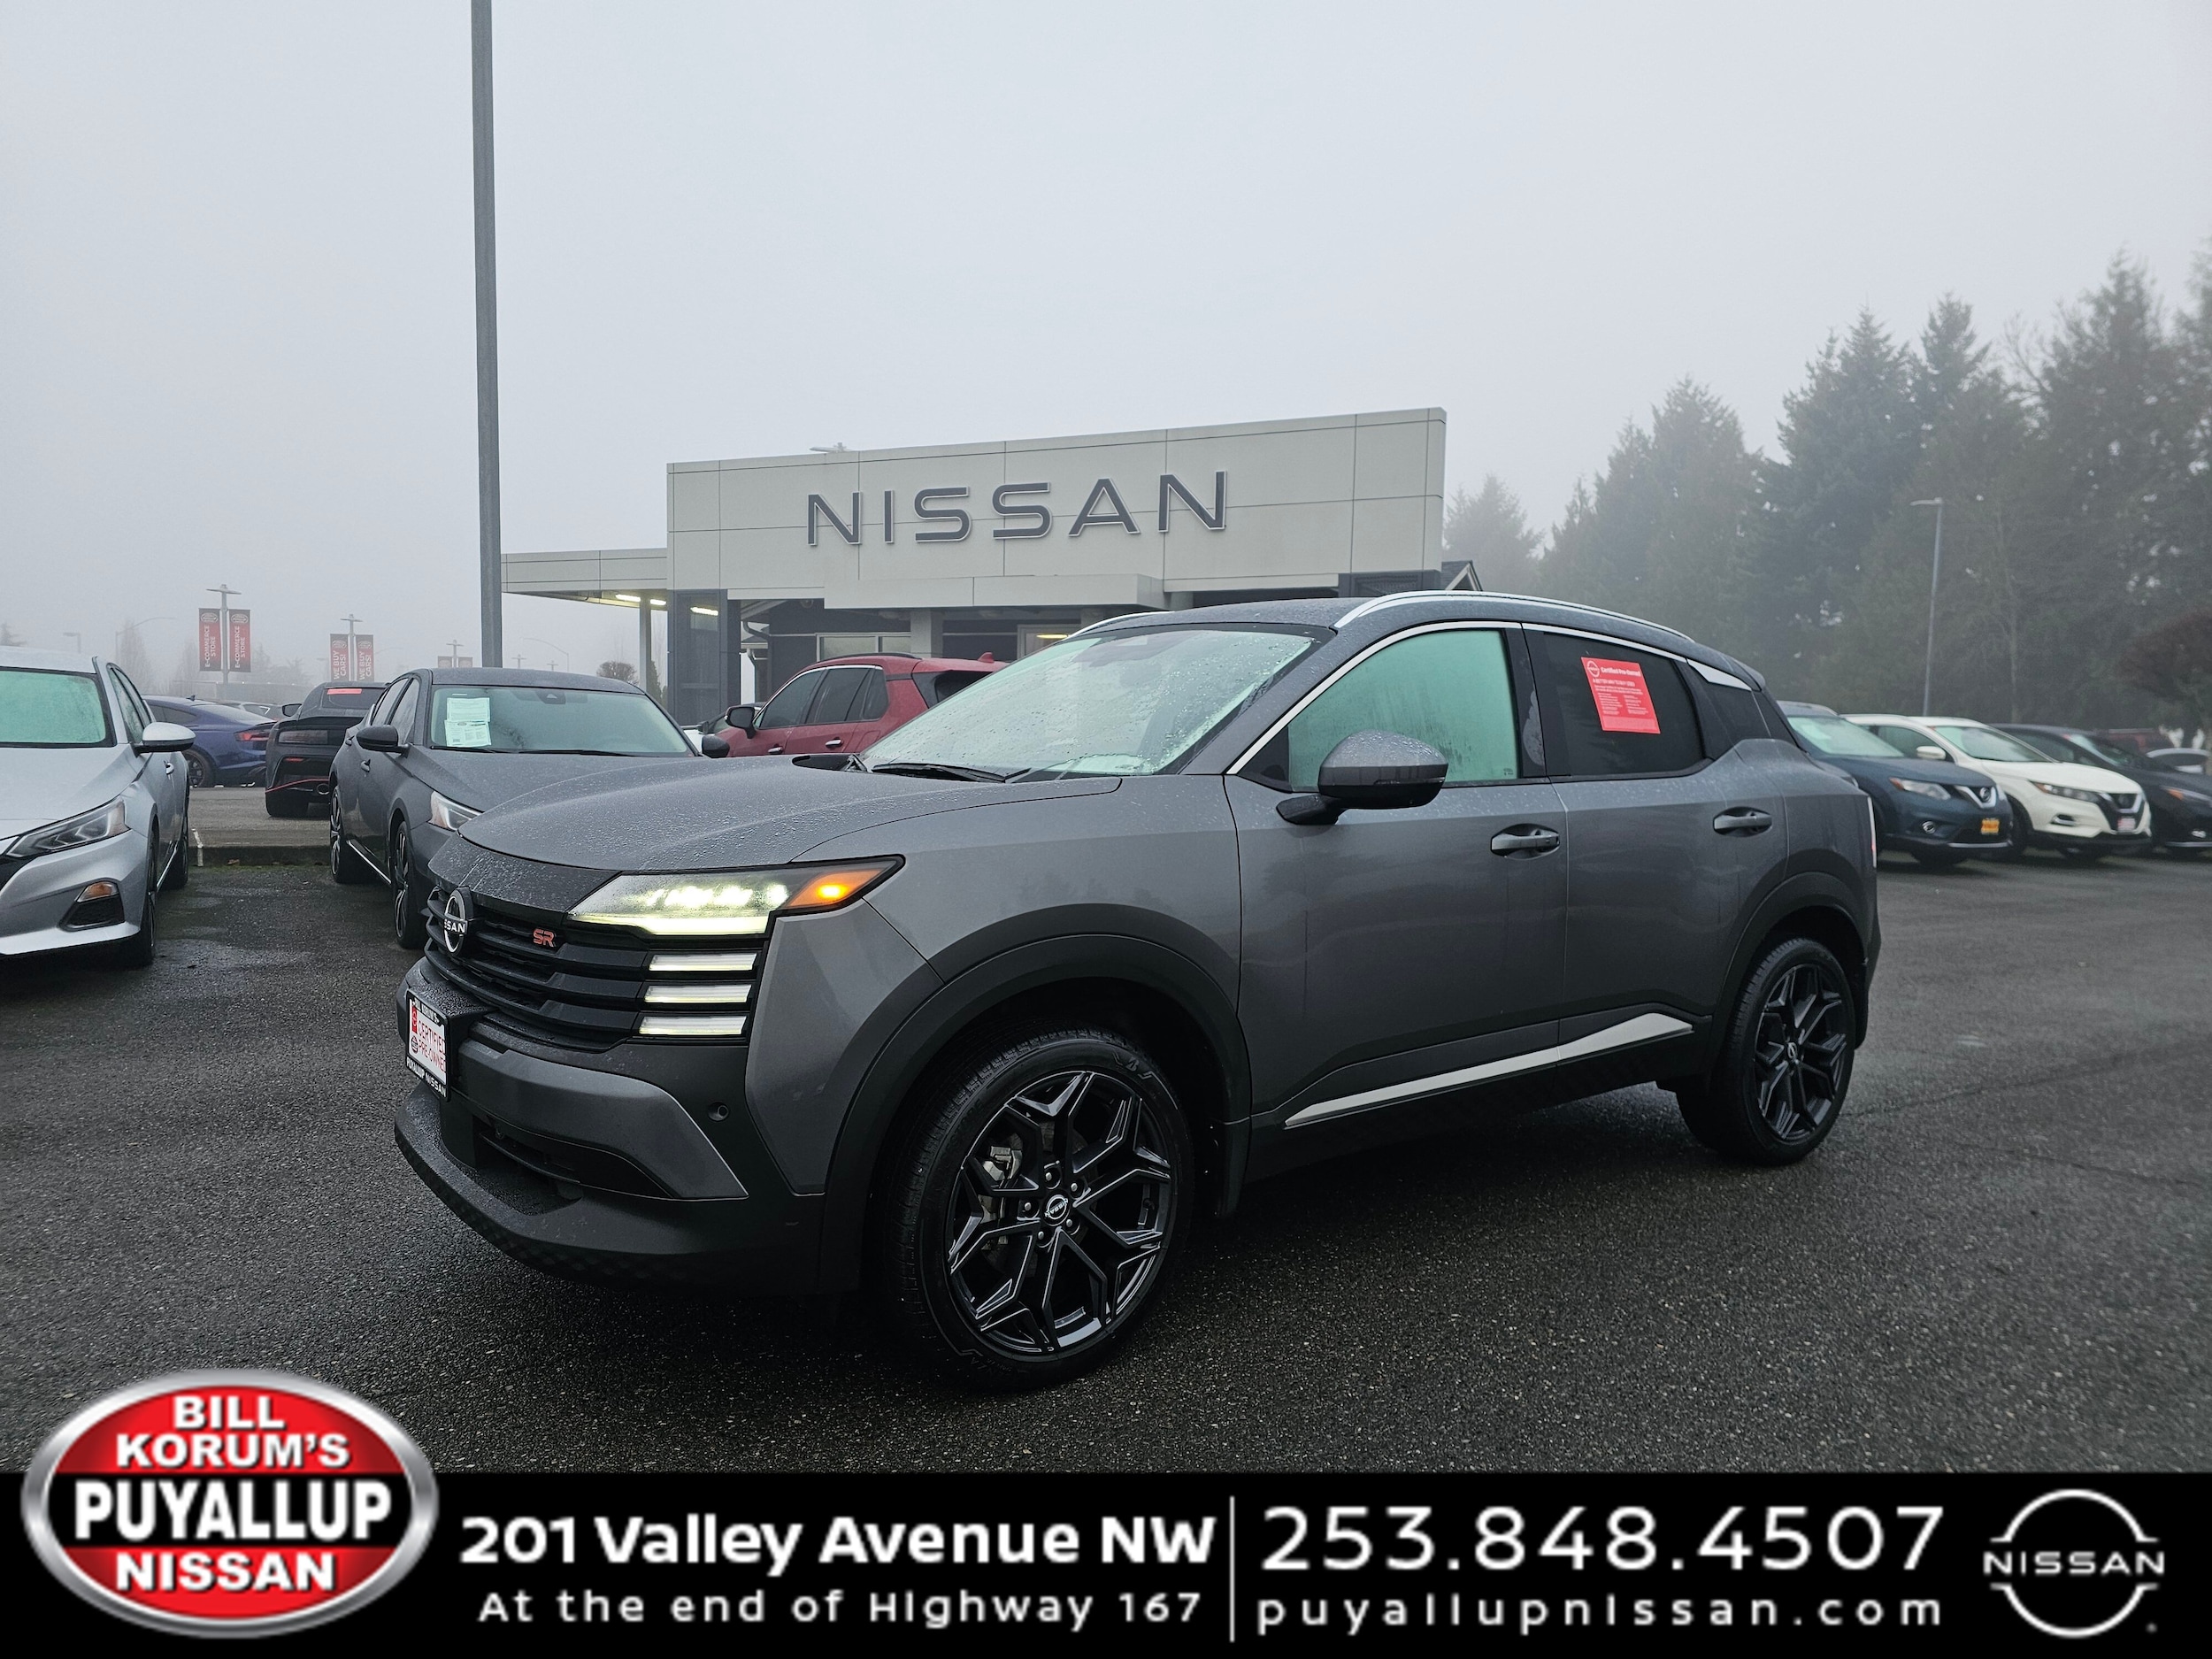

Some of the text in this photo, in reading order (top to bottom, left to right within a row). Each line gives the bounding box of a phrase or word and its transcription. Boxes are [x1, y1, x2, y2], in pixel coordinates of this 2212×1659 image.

[807, 470, 1226, 546] NISSAN
[333, 667, 340, 680] WE
[358, 668, 365, 680] WE
[533, 928, 556, 948] SR
[426, 1071, 446, 1098] NISSAN
[1044, 1197, 1069, 1218] NISSAN
